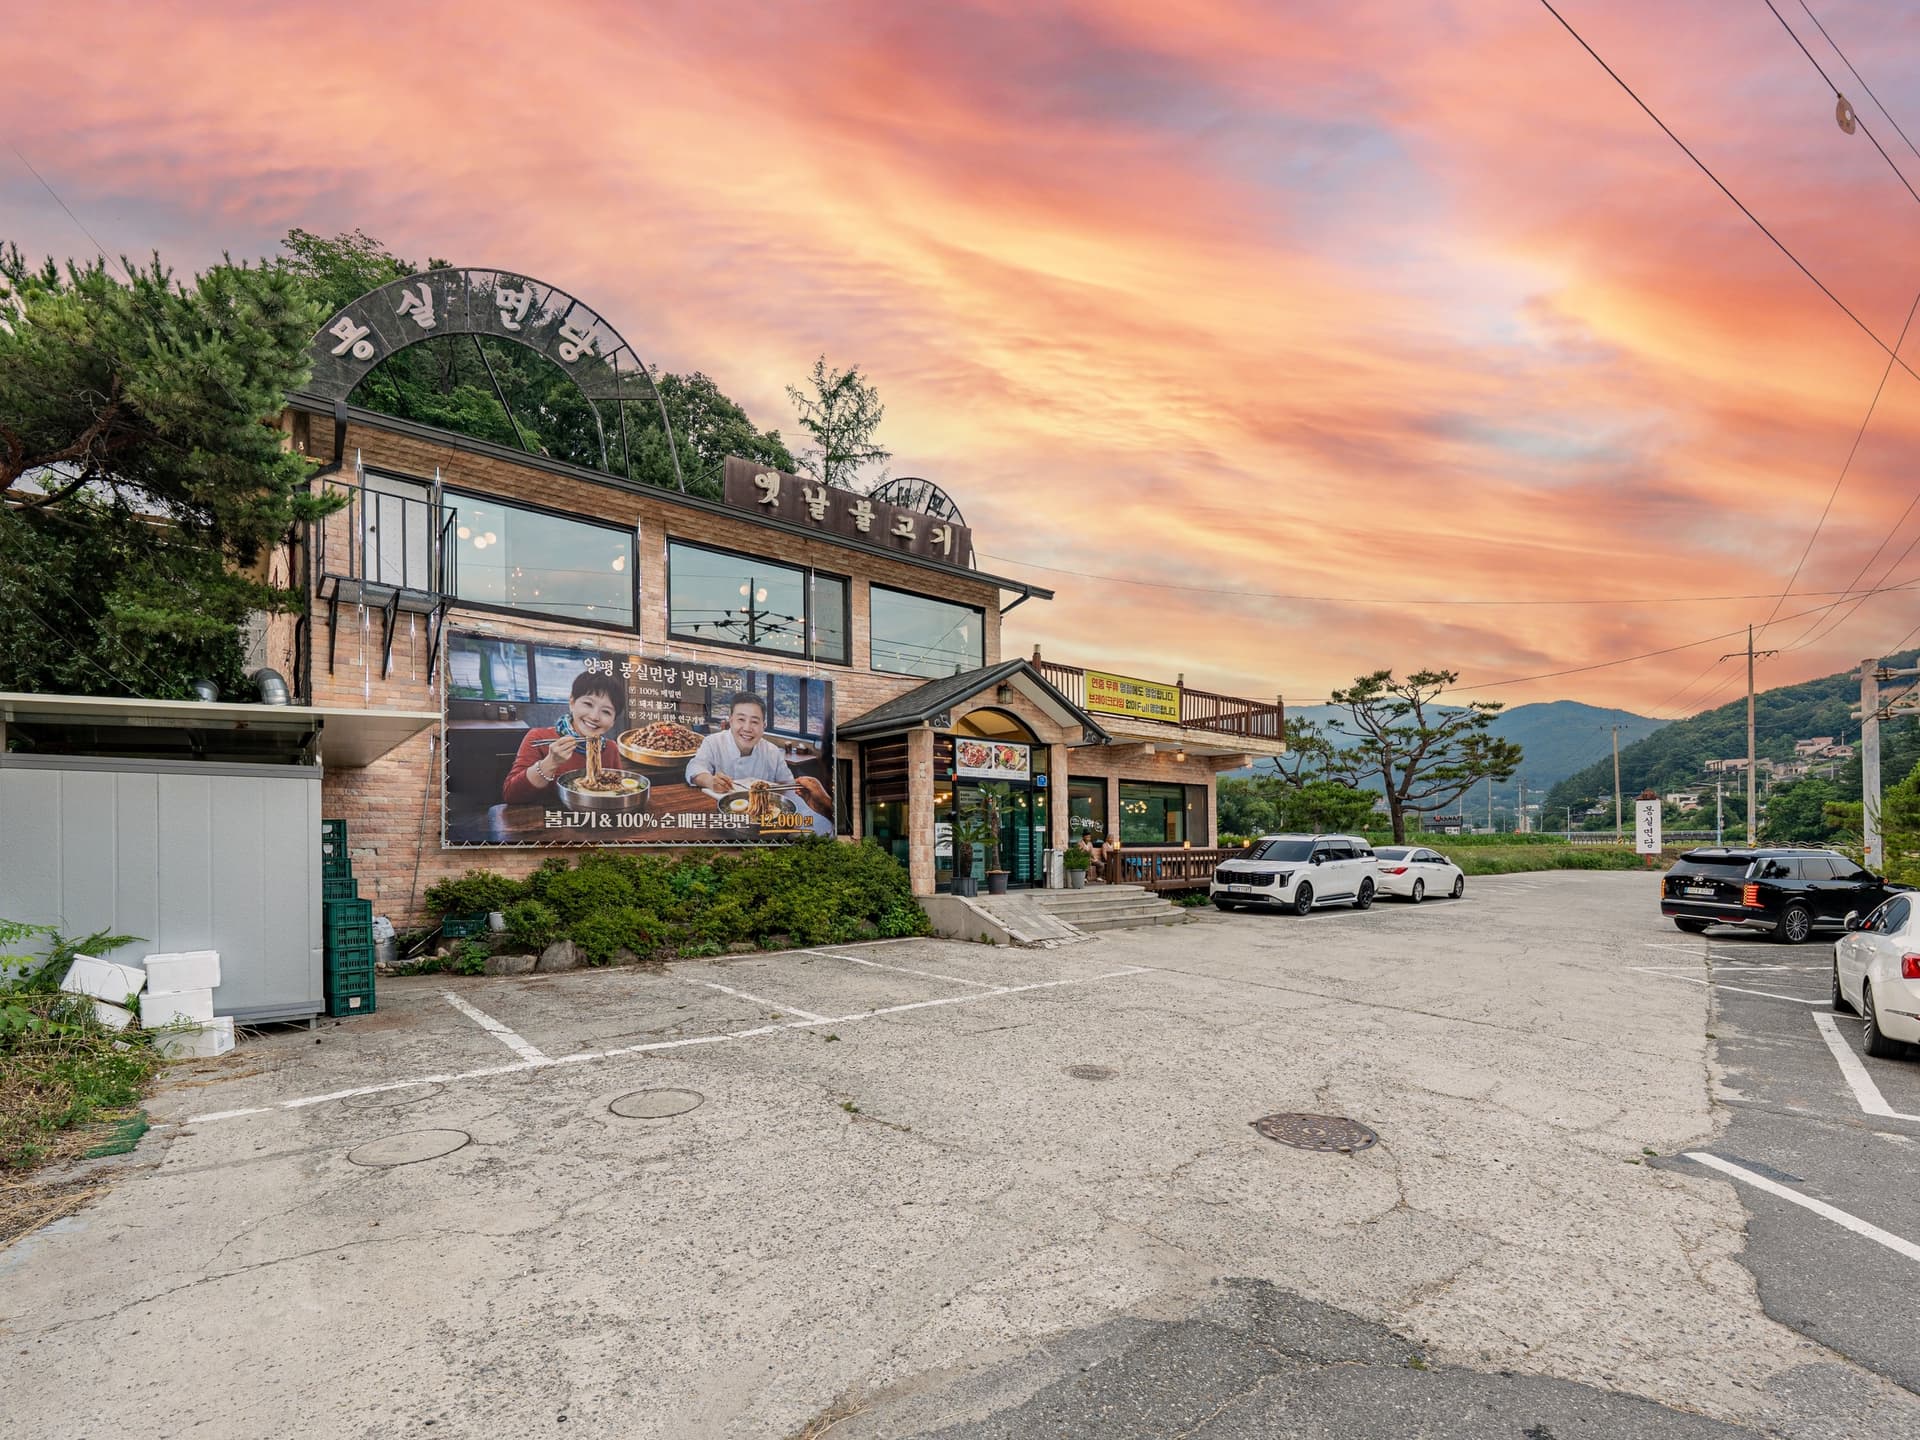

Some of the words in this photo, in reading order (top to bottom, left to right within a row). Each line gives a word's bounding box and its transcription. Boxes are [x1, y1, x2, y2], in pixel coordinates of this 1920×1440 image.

[329, 282, 597, 363] 몽실면당
[584, 657, 614, 676] 양평
[619, 661, 677, 683] 몽실면당
[682, 670, 719, 688] 냉면의
[722, 678, 743, 691] 고집
[639, 687, 659, 696] 100%
[1091, 677, 1104, 689] 연중
[1106, 679, 1118, 692] 무휴
[656, 701, 677, 711] 불고기
[1089, 694, 1124, 708] 브레이크타임
[1137, 702, 1149, 713] Full
[544, 810, 596, 829] 불고기
[600, 813, 612, 828] &
[616, 812, 658, 828] 100%
[678, 812, 707, 829] 메밀
[709, 812, 750, 830] 물냉면
[1643, 805, 1655, 848] 몽실면당
